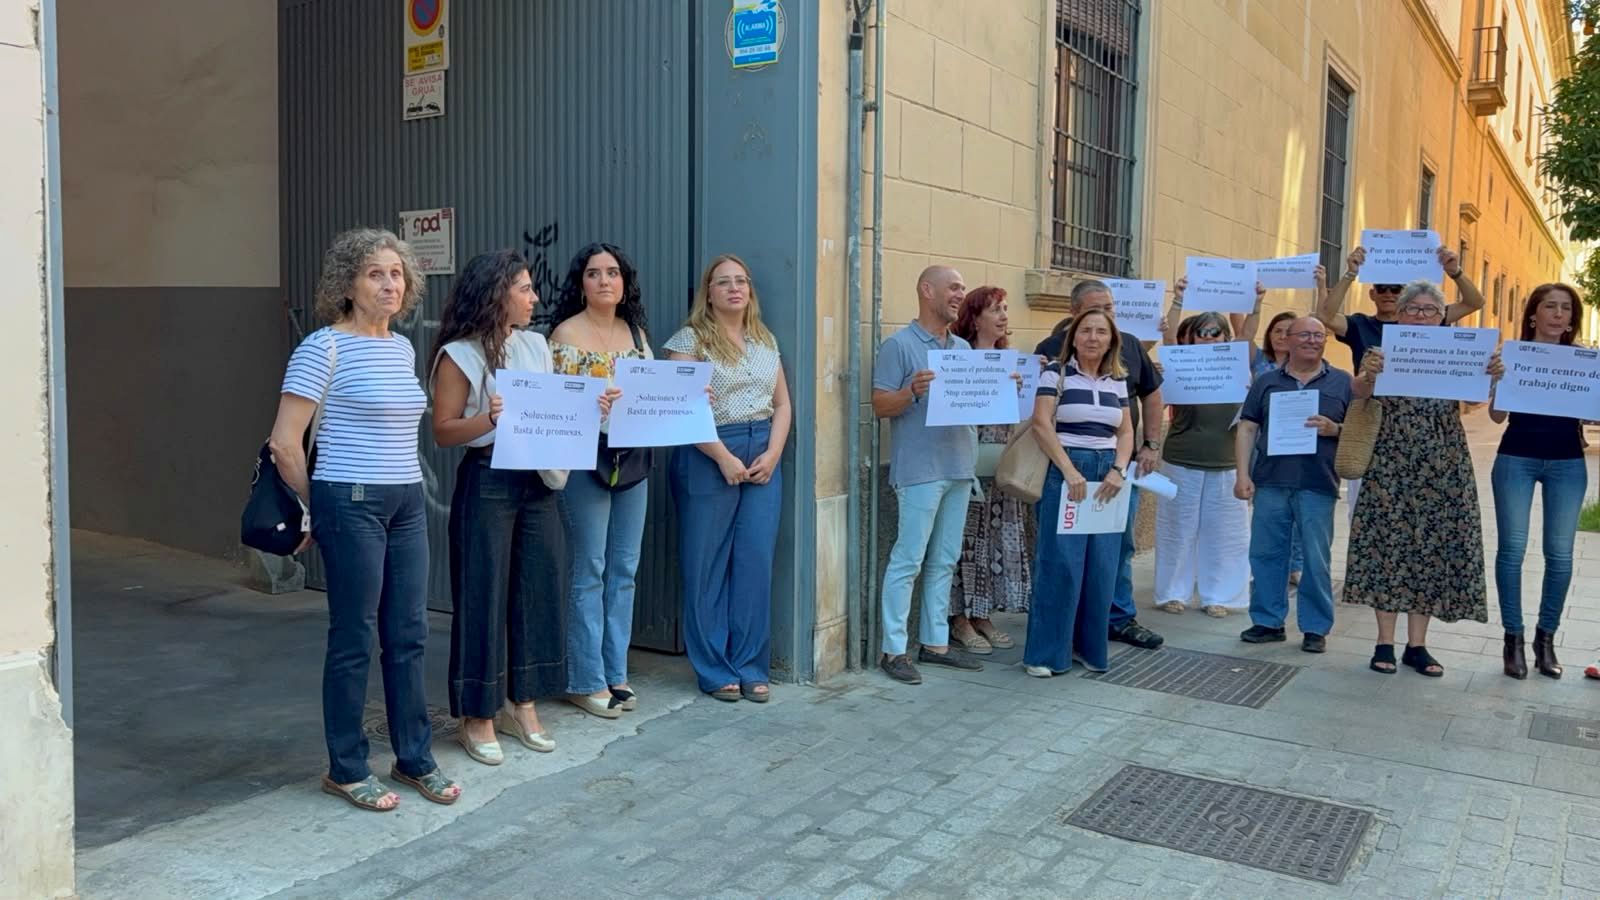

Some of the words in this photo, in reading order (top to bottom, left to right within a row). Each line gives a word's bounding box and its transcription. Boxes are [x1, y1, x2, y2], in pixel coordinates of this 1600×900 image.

[405, 79, 414, 88] SE
[417, 74, 442, 84] AVISA
[411, 86, 435, 97] GRUA
[1374, 258, 1403, 266] trabajo
[1405, 258, 1428, 266] digno
[1131, 300, 1152, 308] centro
[1116, 311, 1134, 320] abajo
[1392, 345, 1408, 353] Las
[1409, 347, 1447, 355] personas
[1470, 350, 1487, 358] que
[1391, 357, 1436, 365] atendemos
[940, 365, 950, 373] No
[968, 365, 975, 373] el
[975, 365, 1007, 374] problema,
[1411, 367, 1448, 375] atención
[1449, 368, 1475, 377] digna.
[1513, 362, 1533, 372] Por
[1535, 365, 1548, 374] un
[1551, 367, 1586, 378] centro
[1518, 378, 1557, 390] trabajo
[1559, 381, 1590, 392] digno
[943, 389, 960, 398] ¡Stop
[960, 389, 989, 398] campaña
[990, 388, 999, 396] de
[635, 393, 675, 404] ¡Soluciones
[677, 394, 688, 405] ya!
[520, 409, 563, 421] ¡Soluciones
[564, 412, 578, 423] ya!
[627, 407, 647, 416] Basta
[648, 407, 657, 416] de
[658, 408, 696, 417] promesas.
[513, 424, 533, 435] Basta
[534, 425, 545, 435] de
[545, 428, 583, 437] promesas.
[1063, 503, 1076, 530] UGT
